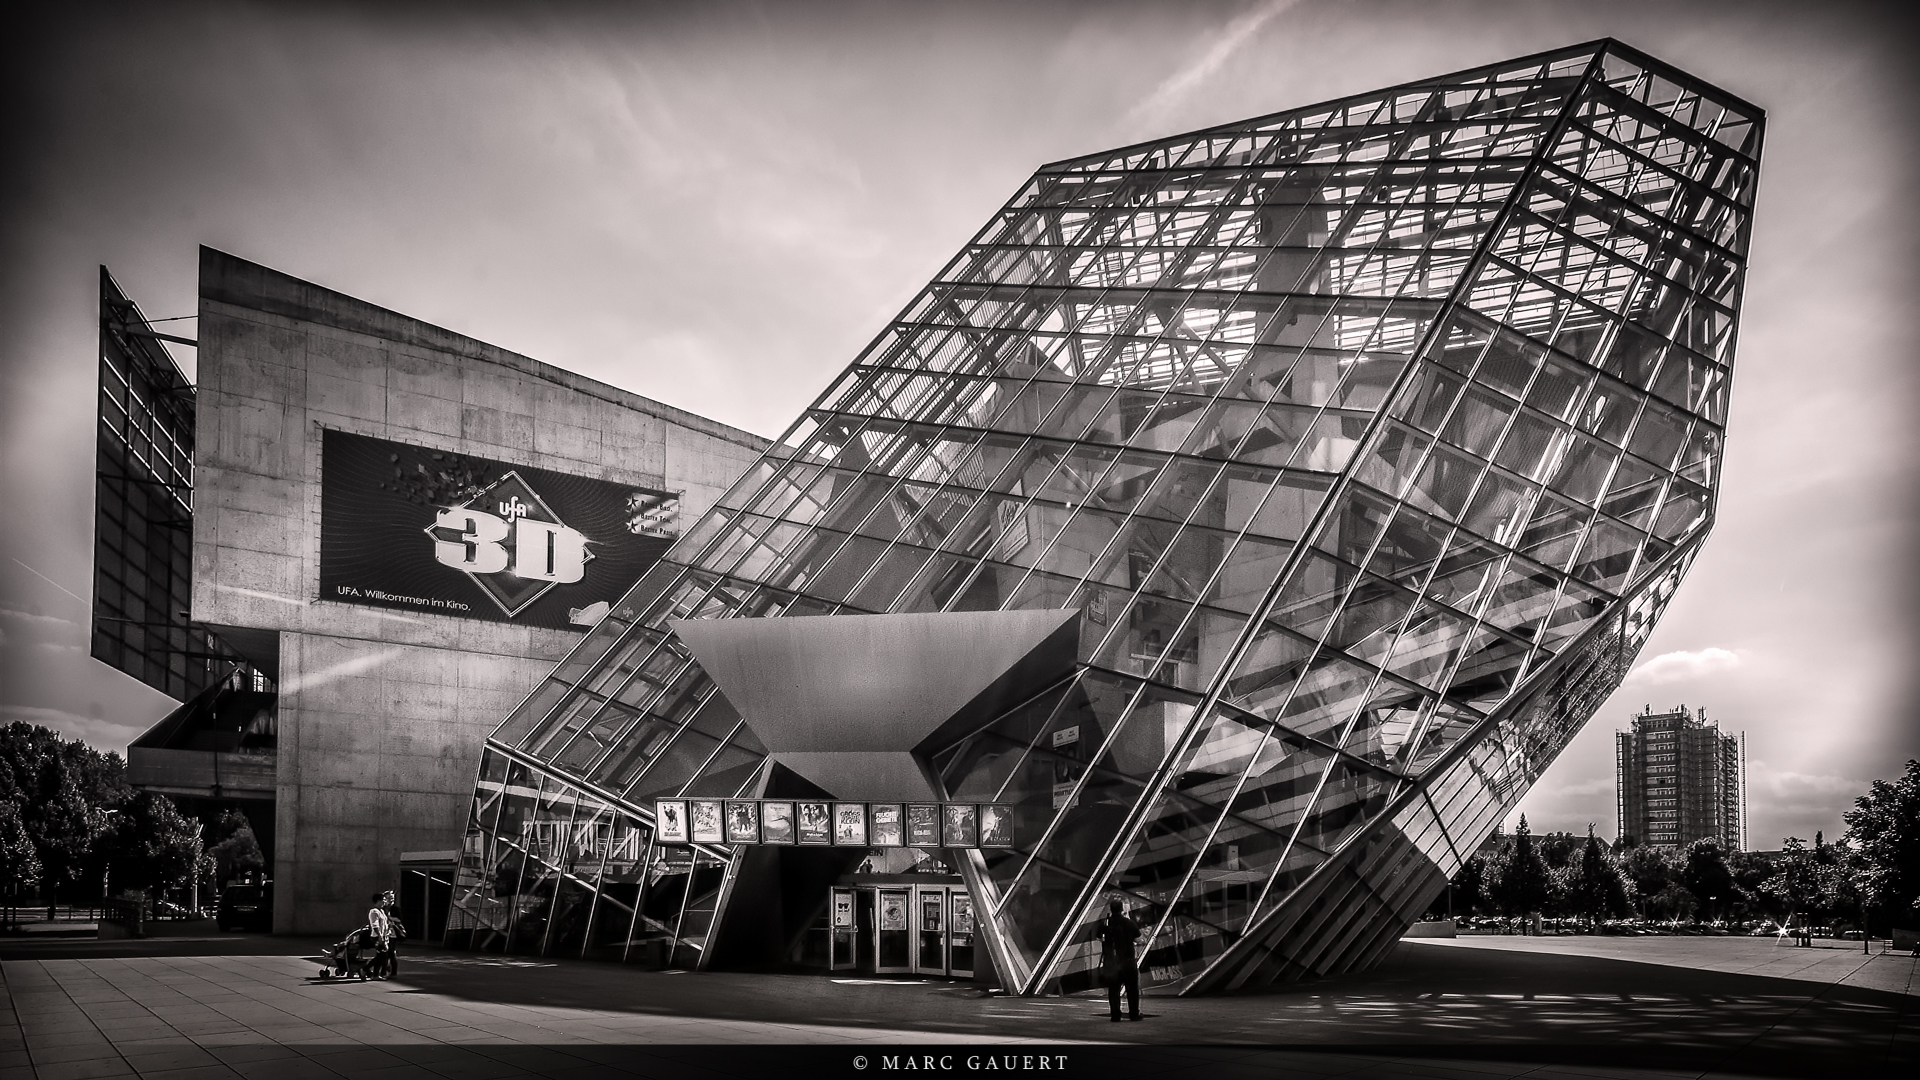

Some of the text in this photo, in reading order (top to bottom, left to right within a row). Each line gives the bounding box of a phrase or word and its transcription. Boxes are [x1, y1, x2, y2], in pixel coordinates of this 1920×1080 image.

[435, 508, 585, 584] 3D
[337, 586, 472, 611] UFA. Willkommen im Kino.
